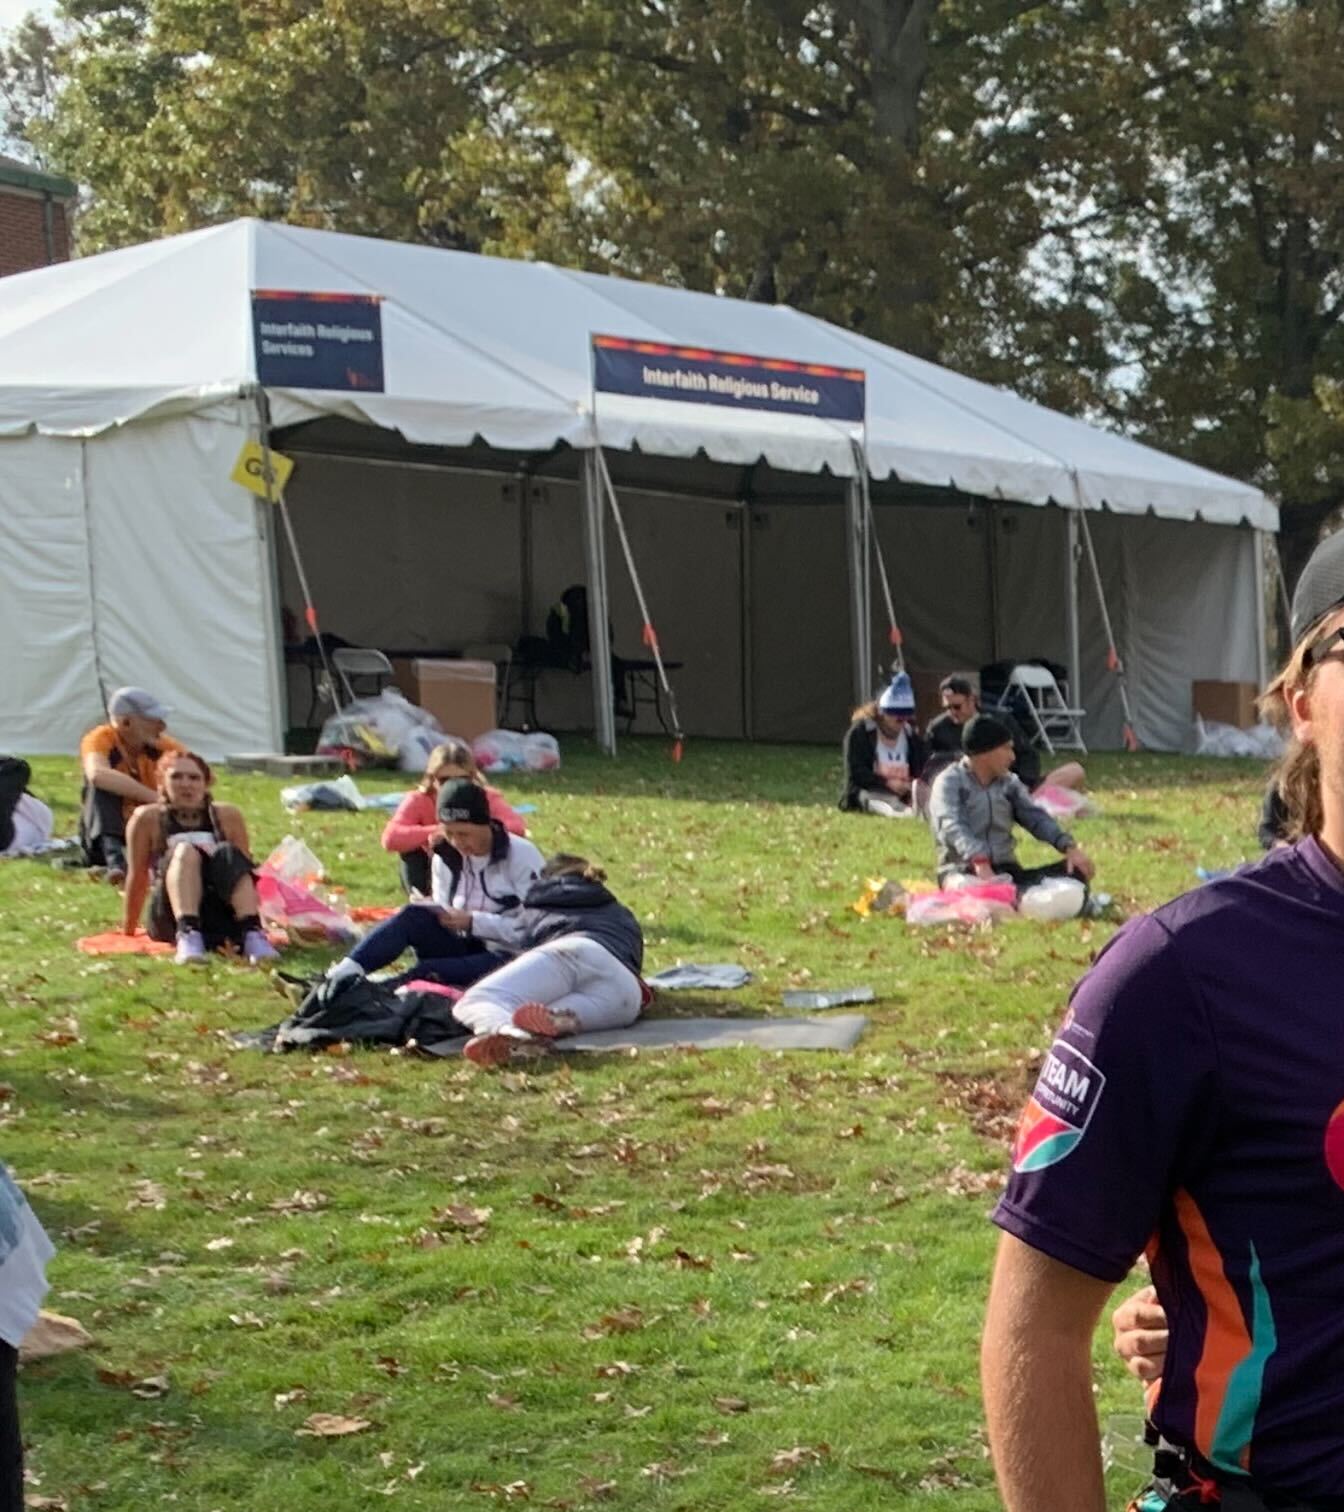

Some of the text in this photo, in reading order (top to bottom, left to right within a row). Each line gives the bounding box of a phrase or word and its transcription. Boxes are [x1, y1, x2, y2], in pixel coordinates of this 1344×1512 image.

[260, 322, 373, 344] Interfaith Religious
[261, 340, 314, 357] Services
[643, 366, 819, 405] Interfaith Religious Service
